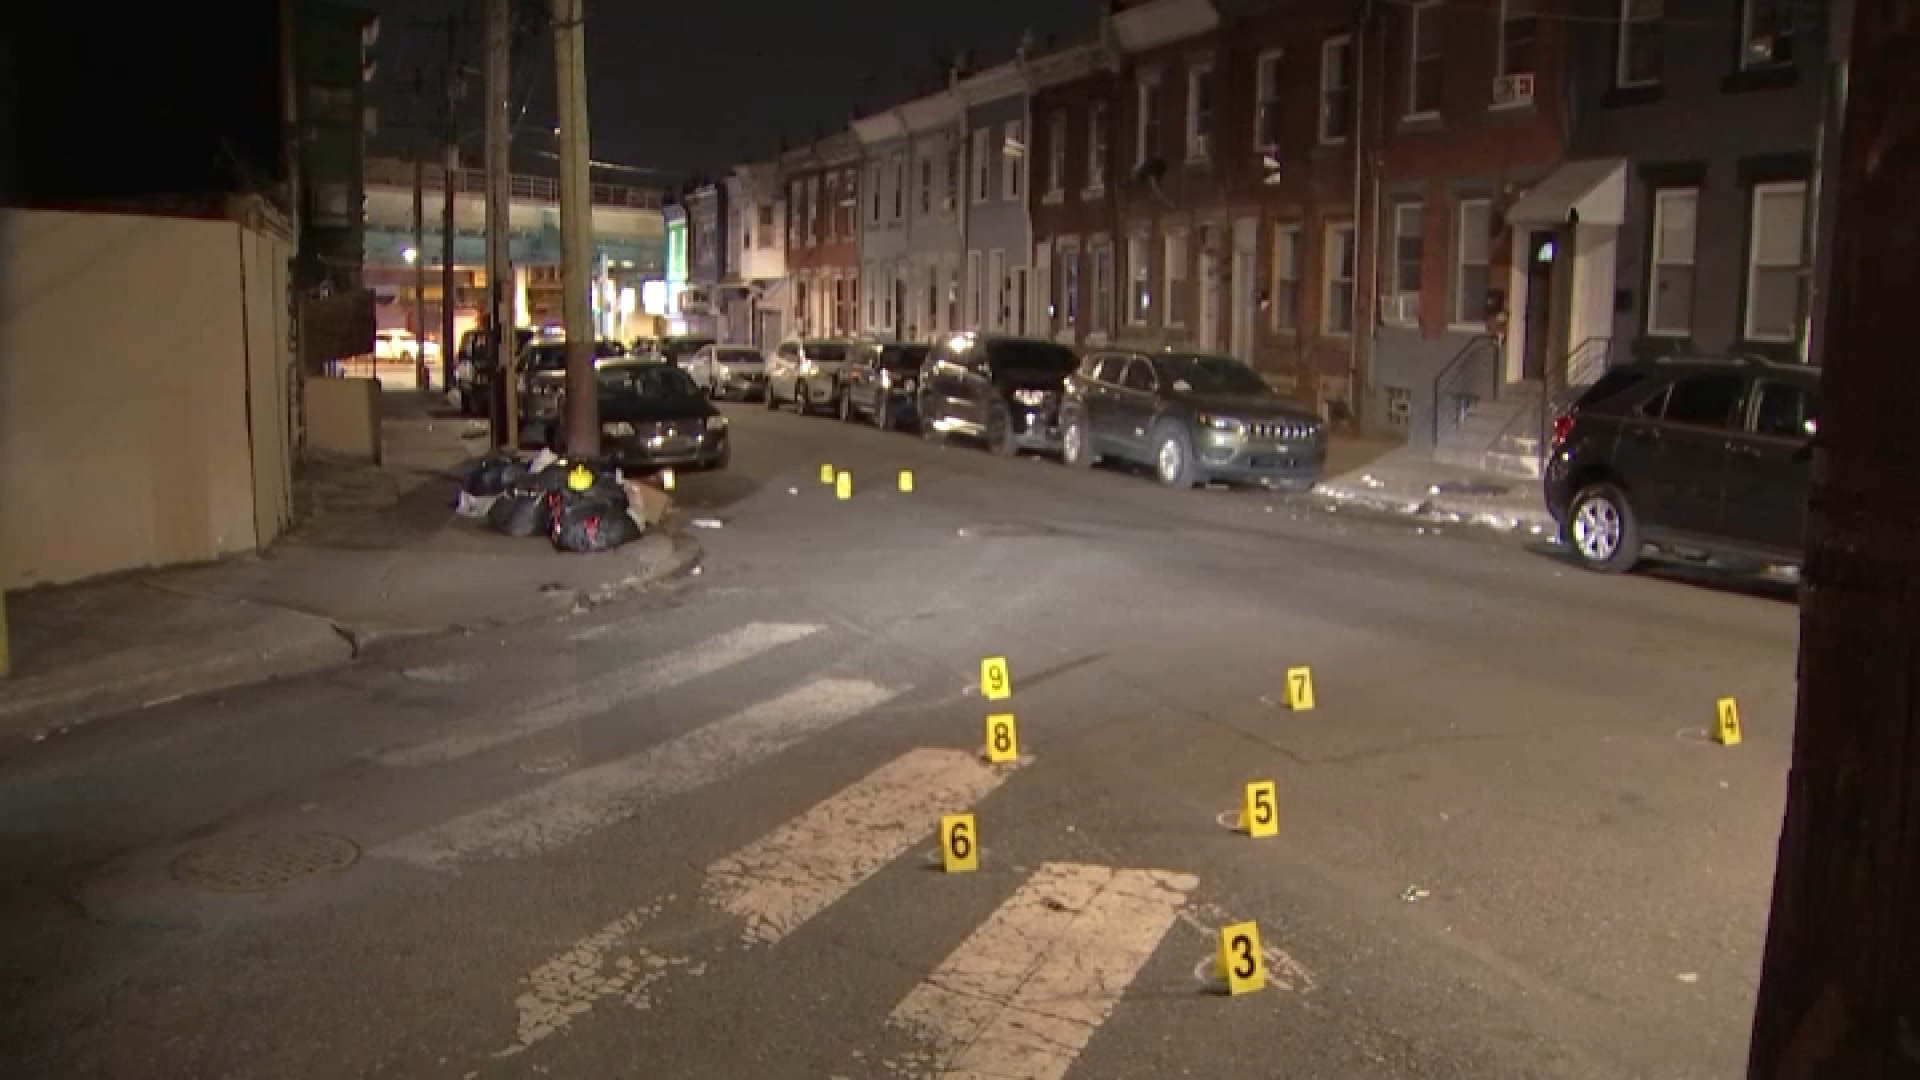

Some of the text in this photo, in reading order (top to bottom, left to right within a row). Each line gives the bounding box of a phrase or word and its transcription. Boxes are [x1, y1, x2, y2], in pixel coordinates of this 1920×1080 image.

[989, 666, 1003, 690] 9
[1293, 674, 1305, 702] 7
[1725, 705, 1736, 735] 4
[994, 722, 1011, 752] 8
[1256, 788, 1272, 824] 5
[952, 822, 971, 860] 6
[1232, 934, 1256, 980] 3
